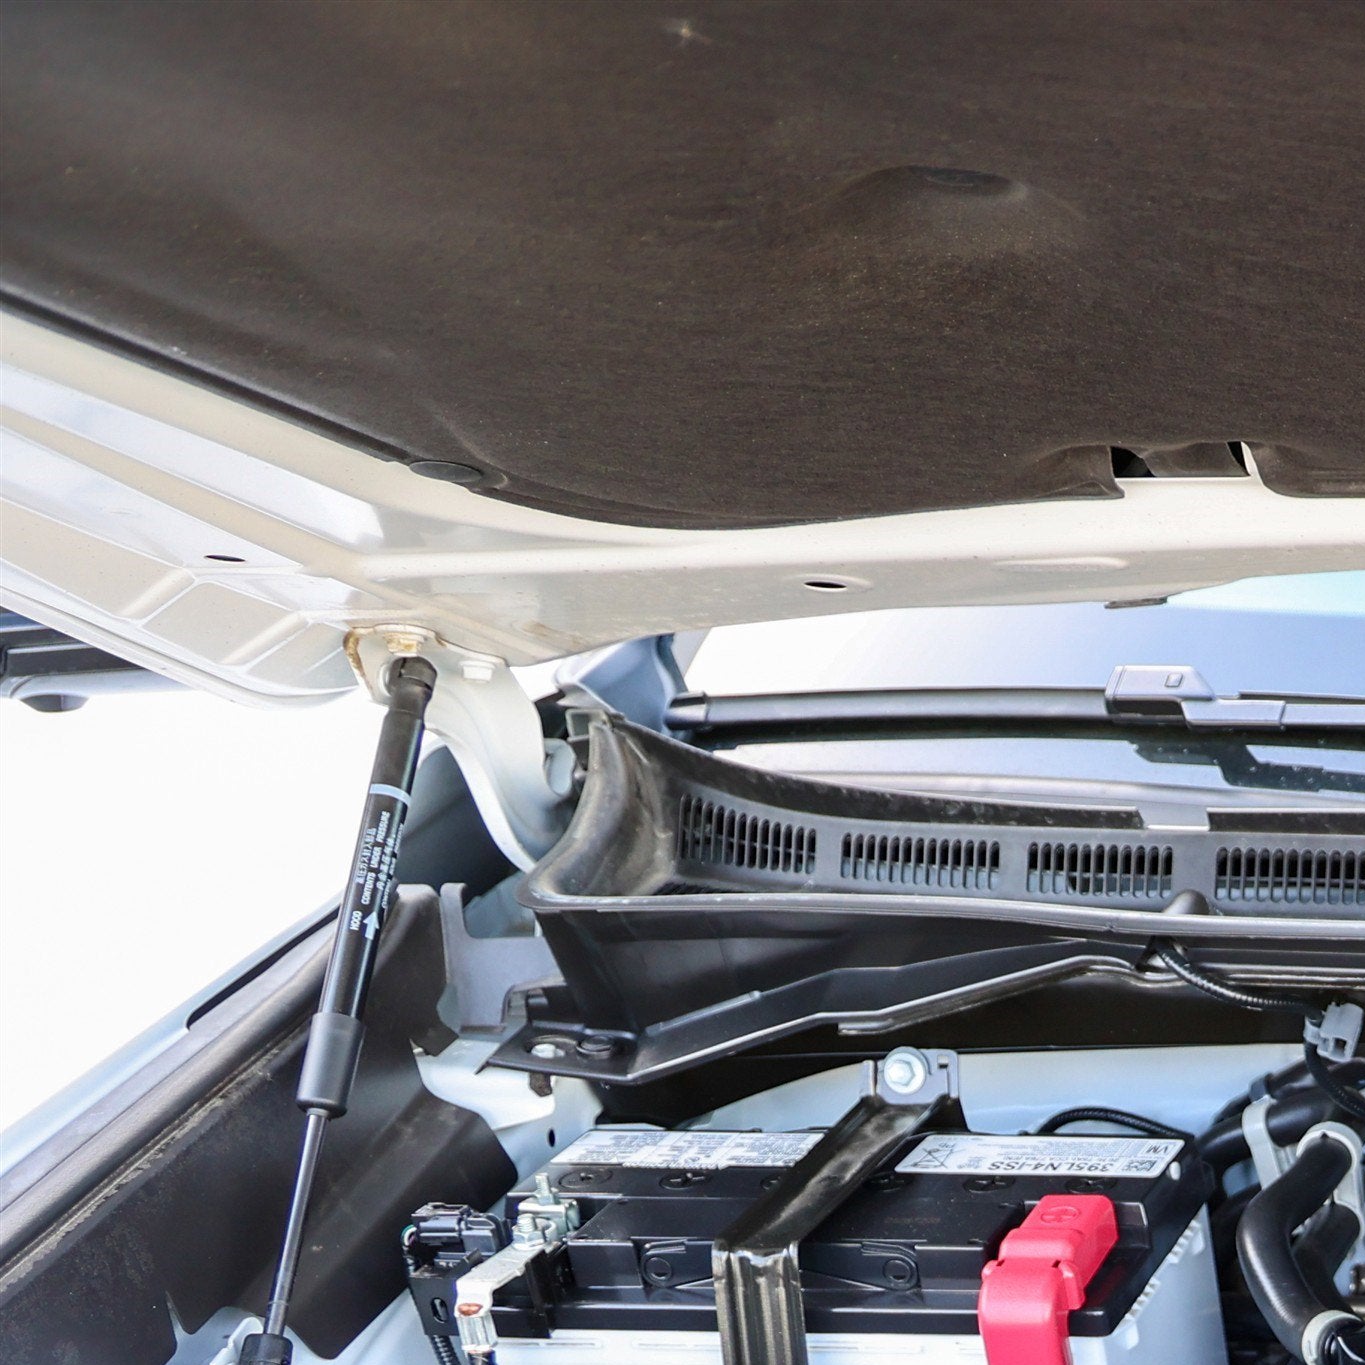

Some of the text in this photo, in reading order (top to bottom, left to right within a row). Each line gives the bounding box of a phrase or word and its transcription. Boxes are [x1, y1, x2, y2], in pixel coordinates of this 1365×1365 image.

[360, 810, 391, 906] CONTENTS UNDER PRESSURE
[349, 910, 363, 931] HOOD
[1145, 1144, 1171, 1155] VM
[987, 1160, 1114, 1173] 395LN4-ISS
